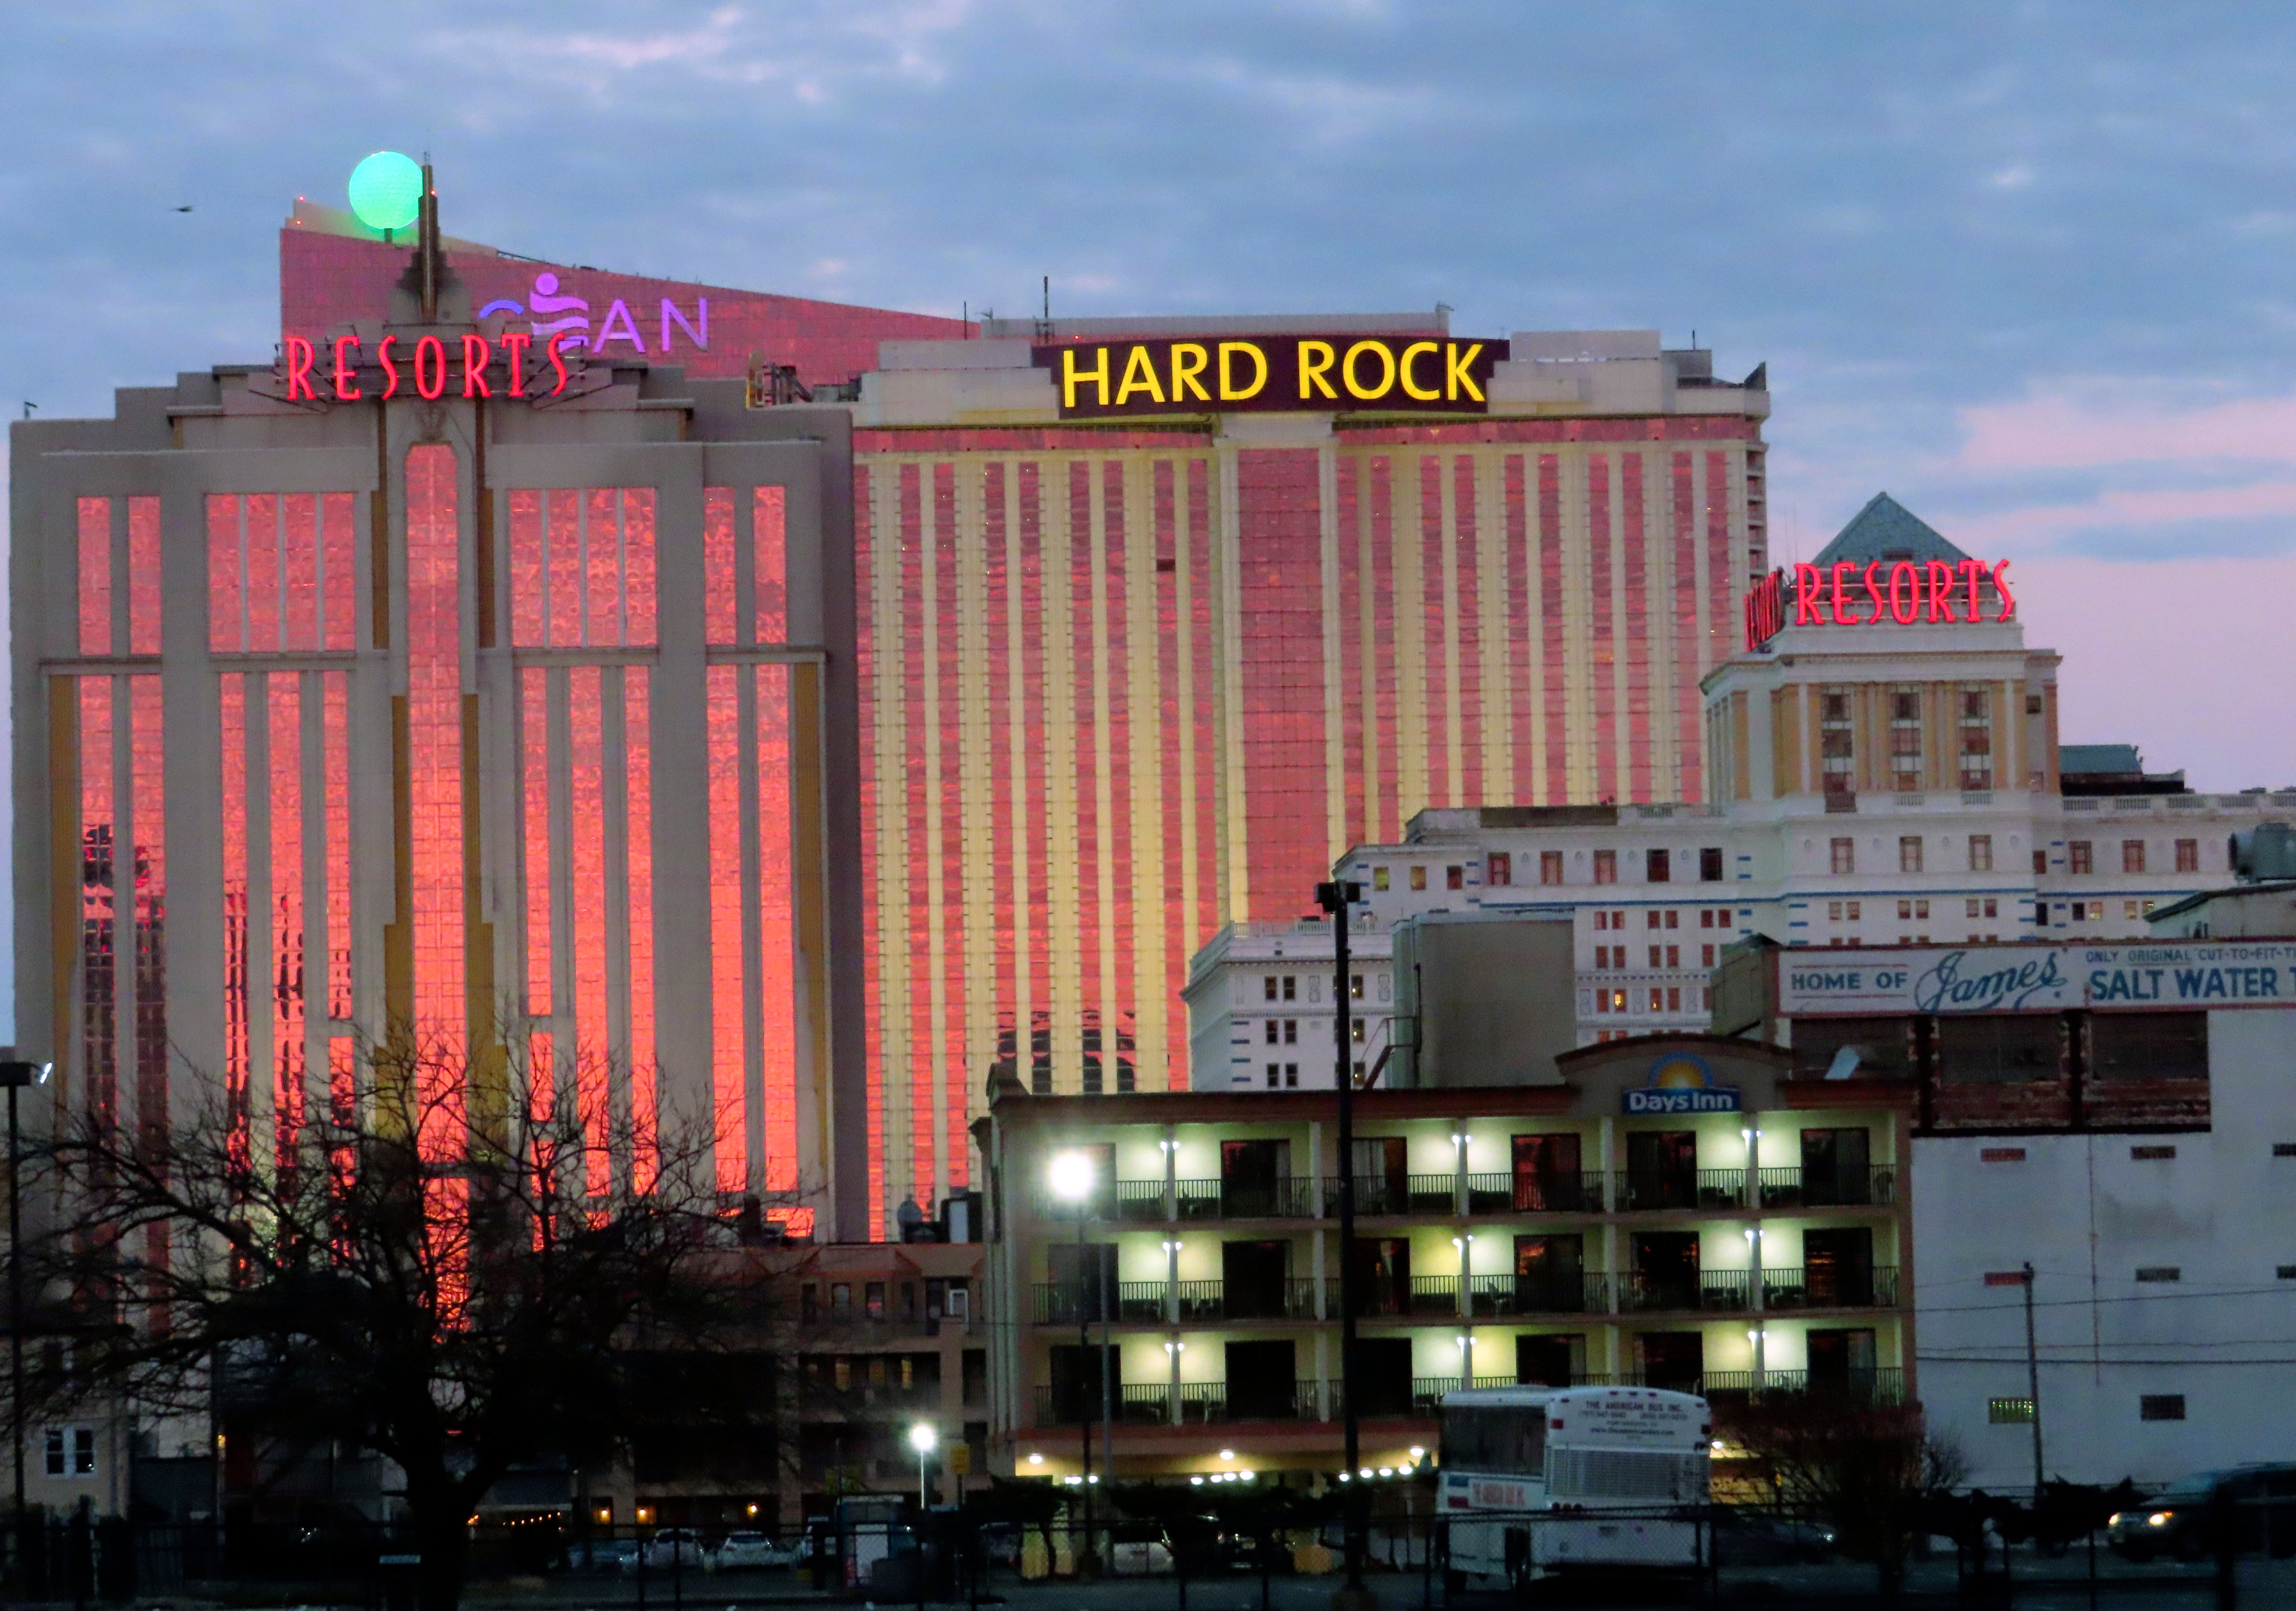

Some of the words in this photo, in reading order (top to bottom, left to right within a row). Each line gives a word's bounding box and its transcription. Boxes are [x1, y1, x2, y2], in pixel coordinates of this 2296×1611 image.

[285, 332, 569, 400] RESORTS
[1063, 341, 1268, 408] HARD
[1297, 340, 1485, 403] ROCK
[1793, 558, 2015, 626] RESORTS
[2086, 950, 2119, 963] ONLY
[2128, 949, 2192, 962] ORIGINAL
[1791, 972, 1861, 991] HOME
[1875, 972, 1908, 989] OF
[2089, 968, 2164, 1000] SALT
[2173, 966, 2278, 998] WATER
[1629, 1092, 1689, 1112] Days
[1692, 1092, 1733, 1110] Inn
[1605, 1401, 1644, 1410] AMERICAN
